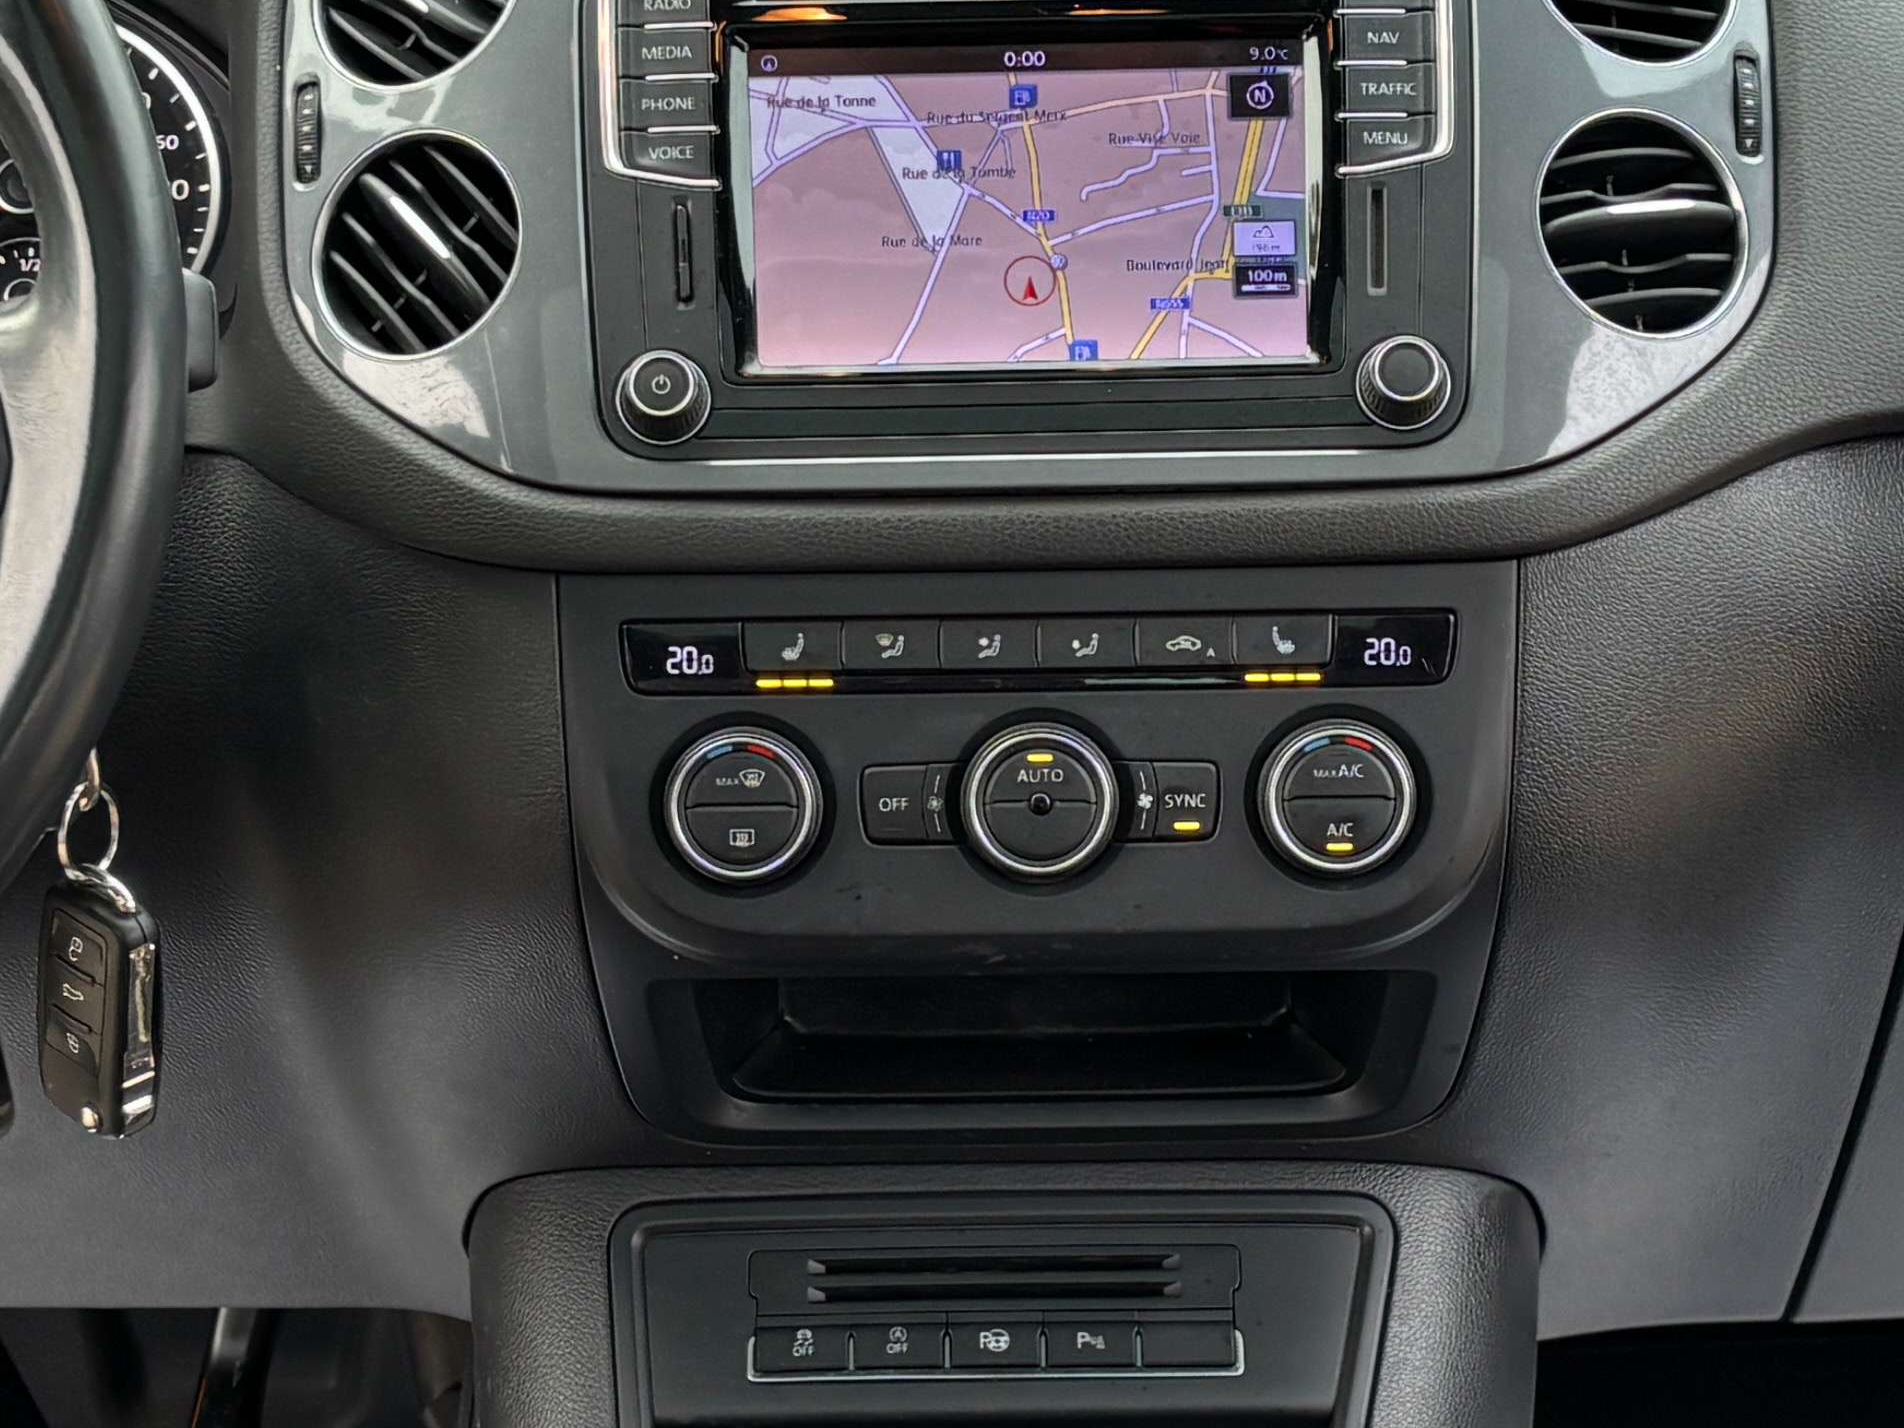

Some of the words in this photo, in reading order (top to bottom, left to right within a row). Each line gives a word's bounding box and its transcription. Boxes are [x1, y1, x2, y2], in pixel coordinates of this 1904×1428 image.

[1367, 31, 1400, 44] NAV
[641, 46, 693, 60] MEDIA
[1004, 50, 1046, 67] 0:00
[1361, 83, 1417, 96] TRAFFIC
[641, 97, 696, 111] PHONE
[766, 96, 793, 109] Rue
[797, 96, 813, 108] de
[1363, 131, 1408, 145] MENU
[648, 145, 695, 160] VOICE
[1363, 637, 1412, 666] 20.0
[665, 645, 715, 675] 20.0
[1017, 768, 1065, 784] AUTO
[1337, 763, 1365, 779] A/C
[878, 797, 909, 813] OFF
[1164, 793, 1207, 809] SYNC
[1326, 823, 1355, 838] A/C
[792, 1345, 815, 1357] OFF
[886, 1342, 909, 1355] OFF
